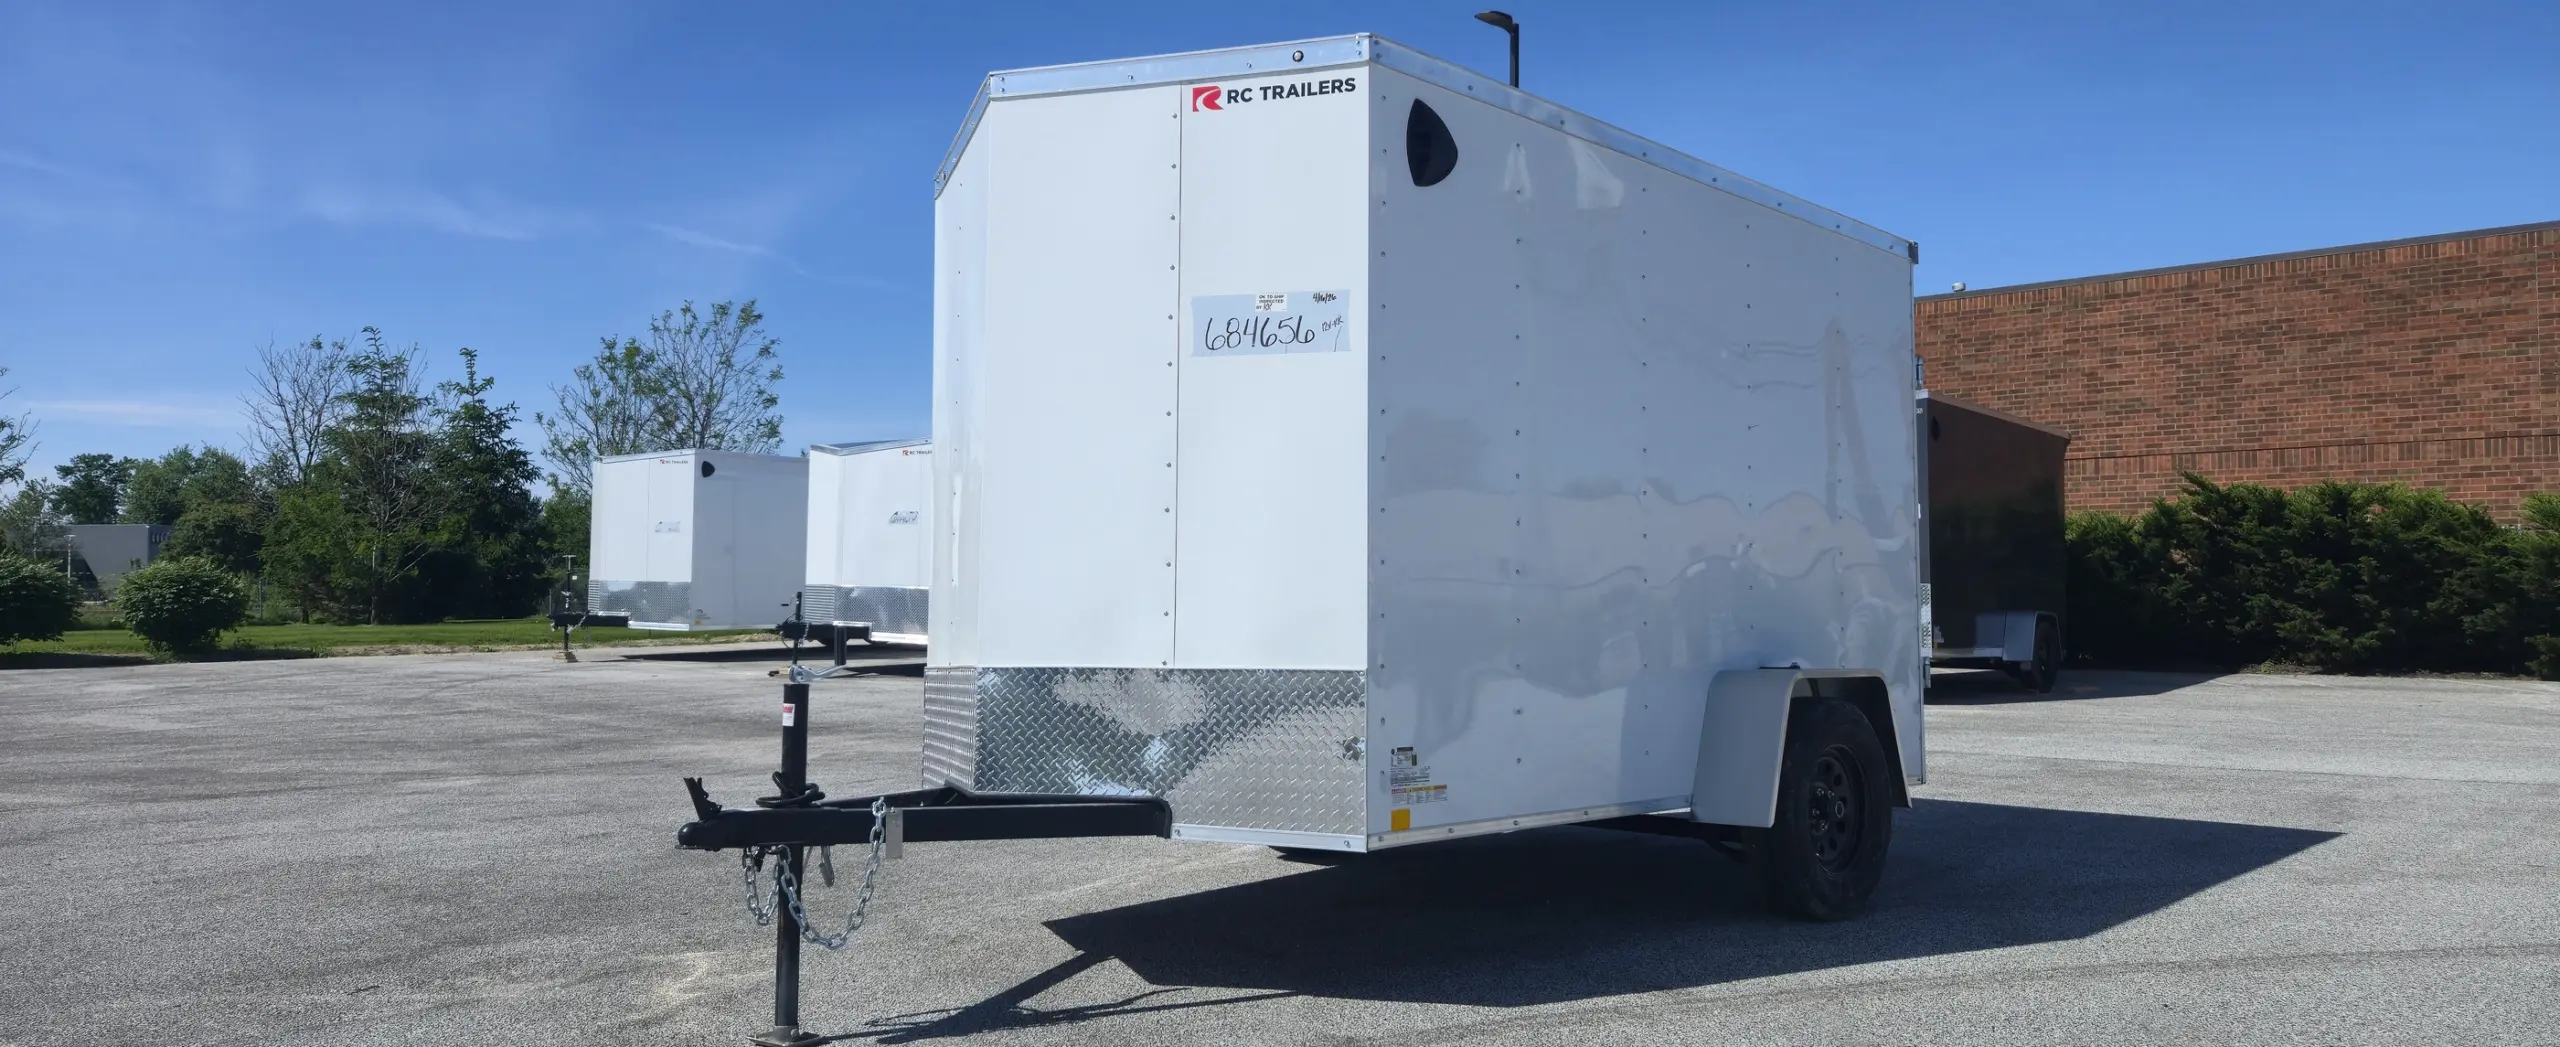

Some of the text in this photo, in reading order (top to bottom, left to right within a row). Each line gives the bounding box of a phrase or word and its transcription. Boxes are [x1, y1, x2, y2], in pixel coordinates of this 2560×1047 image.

[1227, 77, 1357, 104] RC TRAILERS
[1205, 315, 1315, 350] 684656
